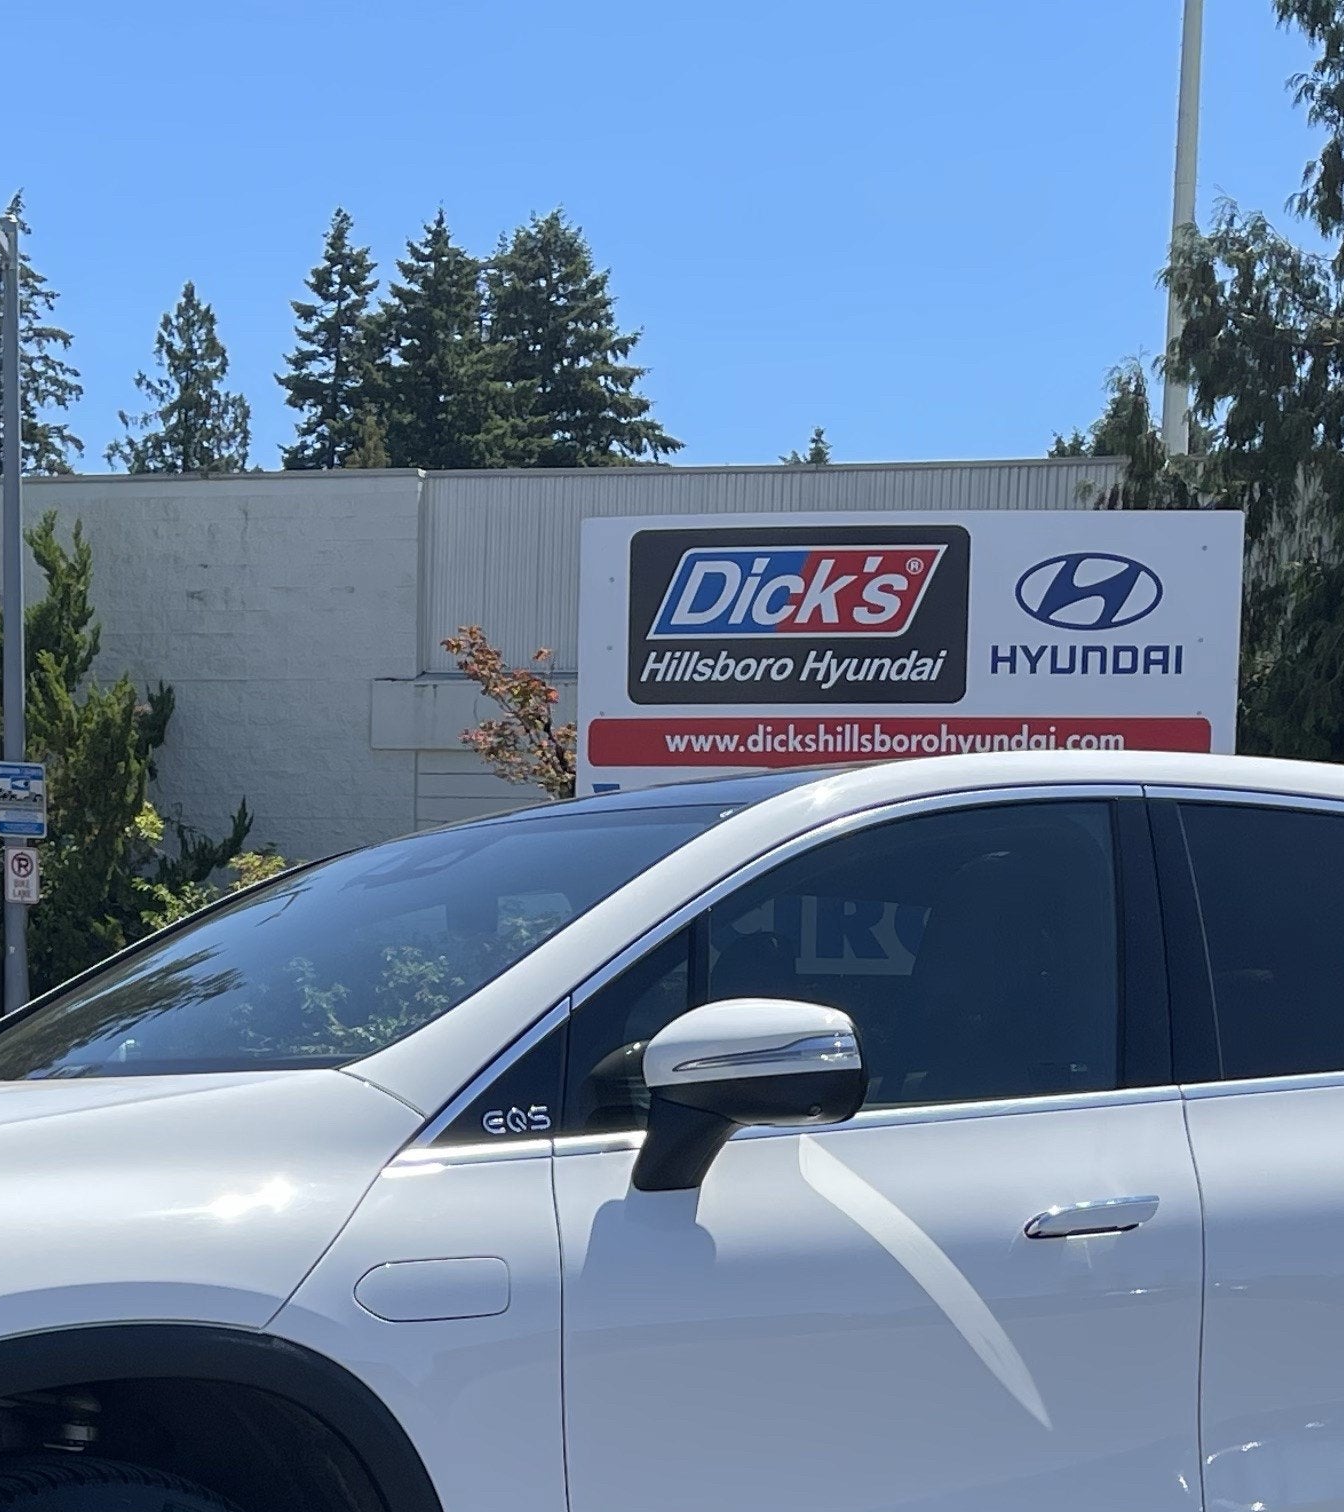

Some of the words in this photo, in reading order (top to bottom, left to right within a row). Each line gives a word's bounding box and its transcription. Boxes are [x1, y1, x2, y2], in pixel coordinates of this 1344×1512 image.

[640, 650, 794, 683] Hillsboro
[799, 650, 948, 690] Hyundai
[991, 645, 1183, 675] HYUNDAI
[665, 723, 1125, 754] www.dickshillsborohyundai.com
[482, 1105, 551, 1134] EQS
